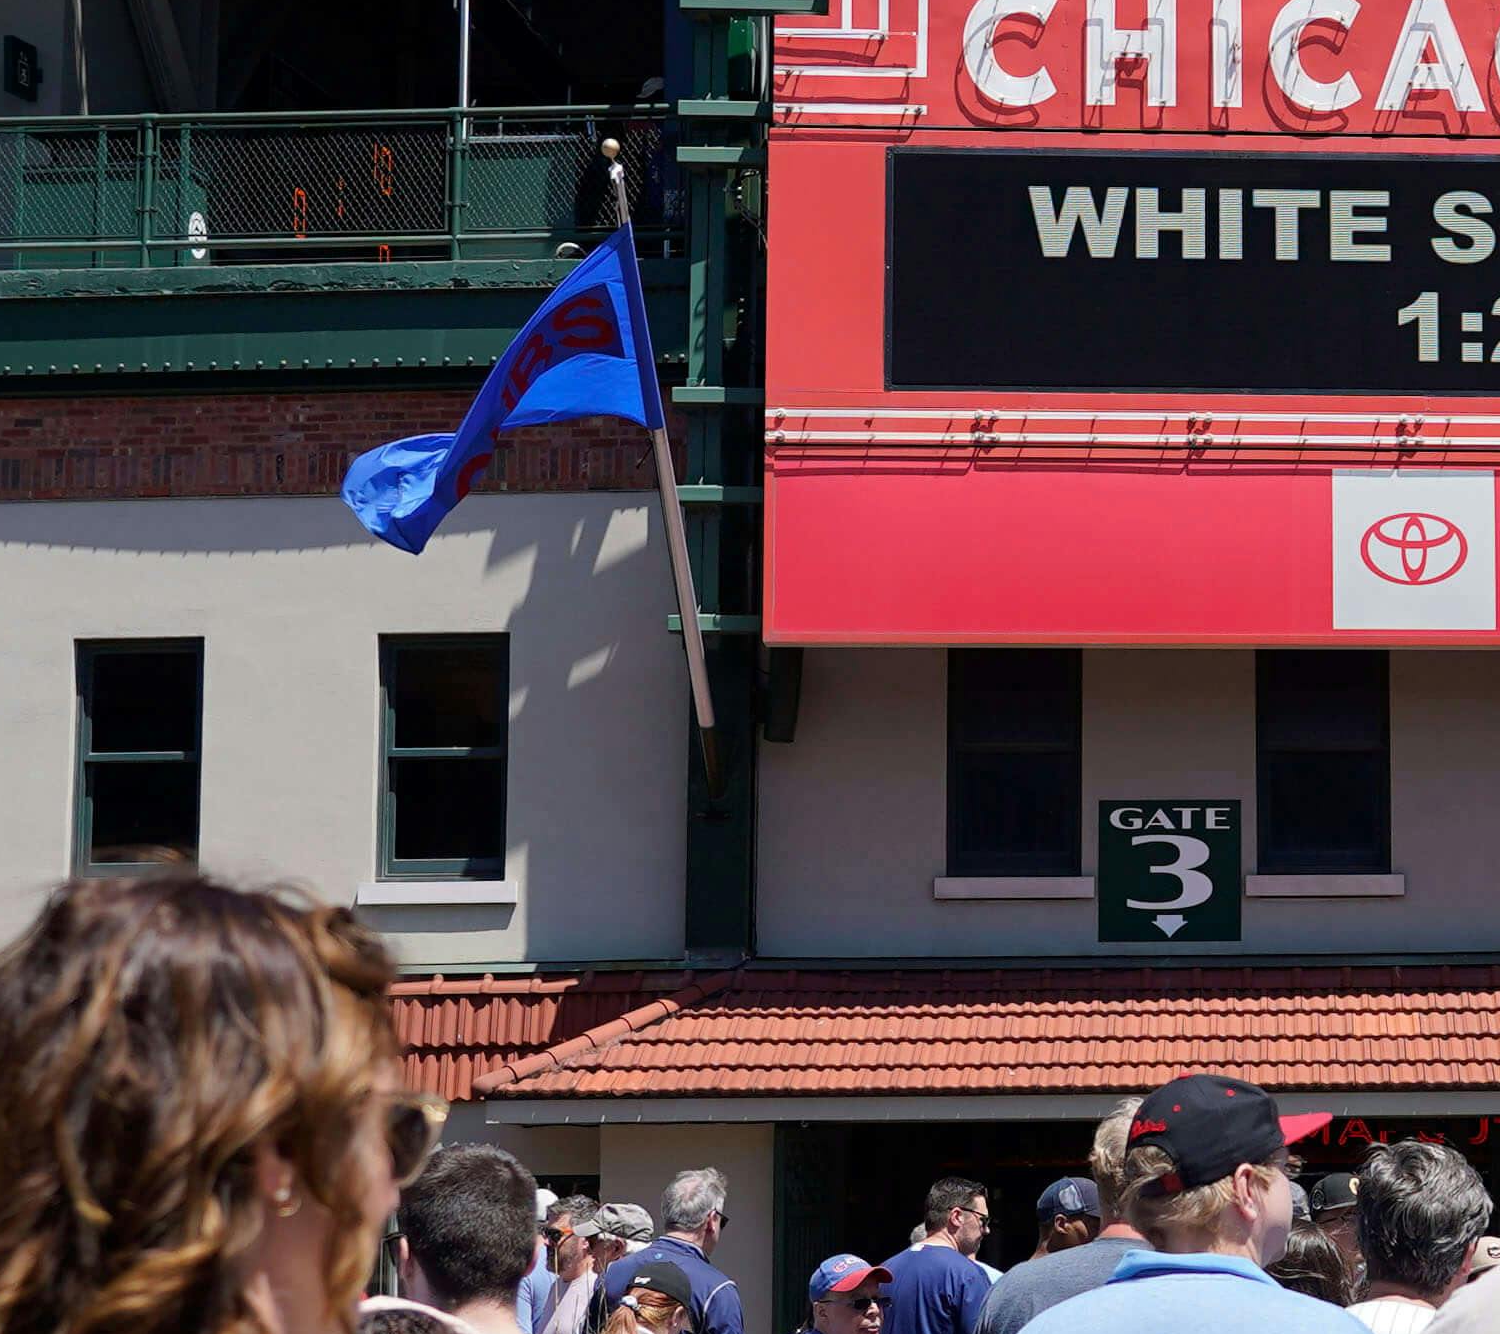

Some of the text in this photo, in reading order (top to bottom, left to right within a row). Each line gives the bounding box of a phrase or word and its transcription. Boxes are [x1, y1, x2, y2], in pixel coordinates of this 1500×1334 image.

[1027, 185, 1393, 263] WHITE
[1109, 807, 1231, 830] GATE
[1126, 834, 1214, 910] 3
